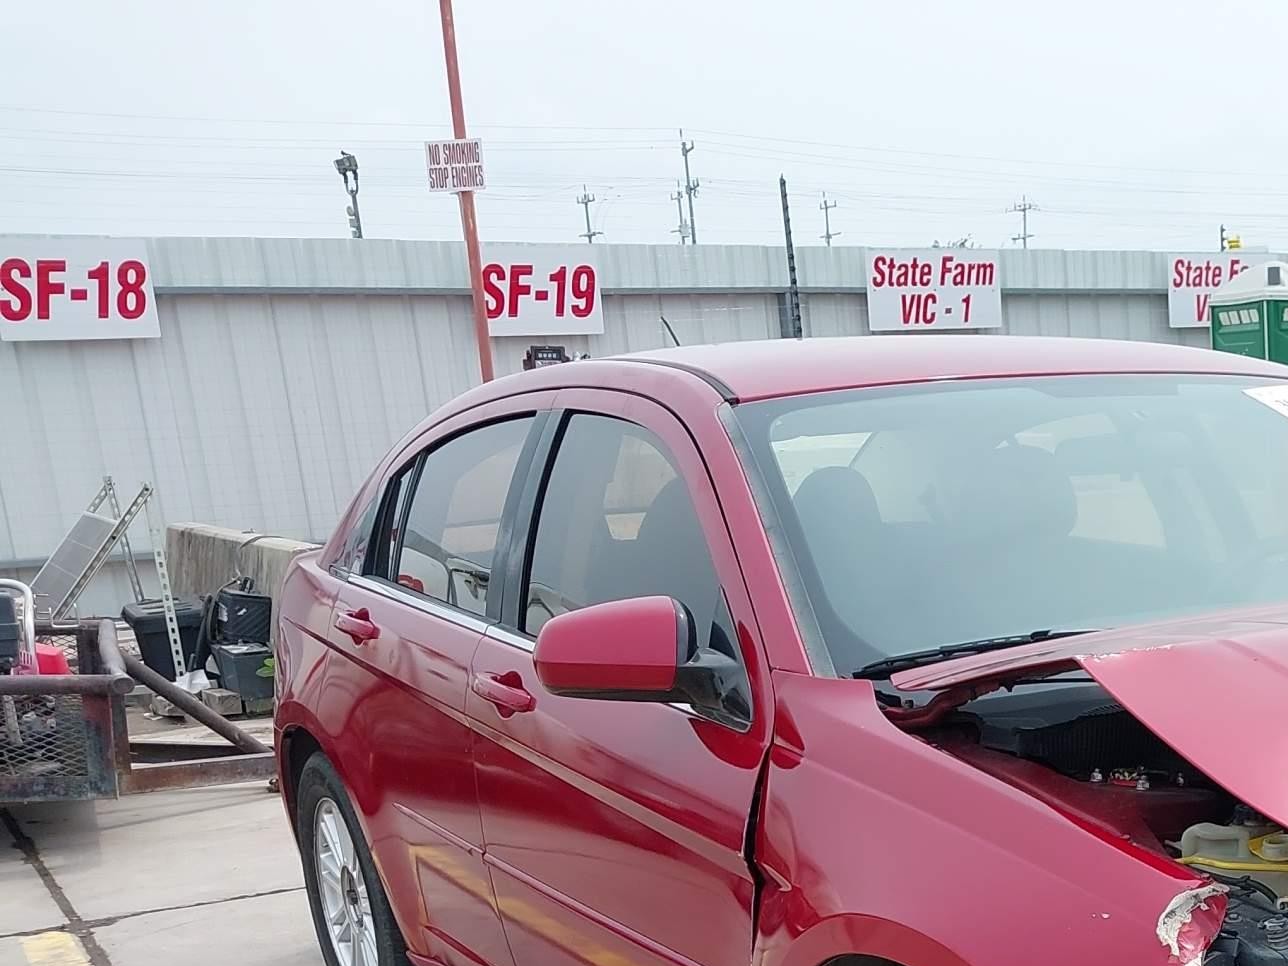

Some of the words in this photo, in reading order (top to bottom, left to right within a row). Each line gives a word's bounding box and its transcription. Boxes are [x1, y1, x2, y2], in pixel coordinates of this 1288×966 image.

[428, 143, 441, 166] NO
[443, 141, 480, 166] SMOKING
[428, 167, 449, 189] STOP
[451, 164, 484, 188] ENGINES
[872, 256, 932, 288] State
[940, 256, 995, 288] Farm
[1173, 259, 1222, 288] State
[0, 258, 147, 322] SF-18
[485, 263, 596, 320] SF-19
[901, 293, 937, 325] VIC
[960, 294, 971, 323] 1
